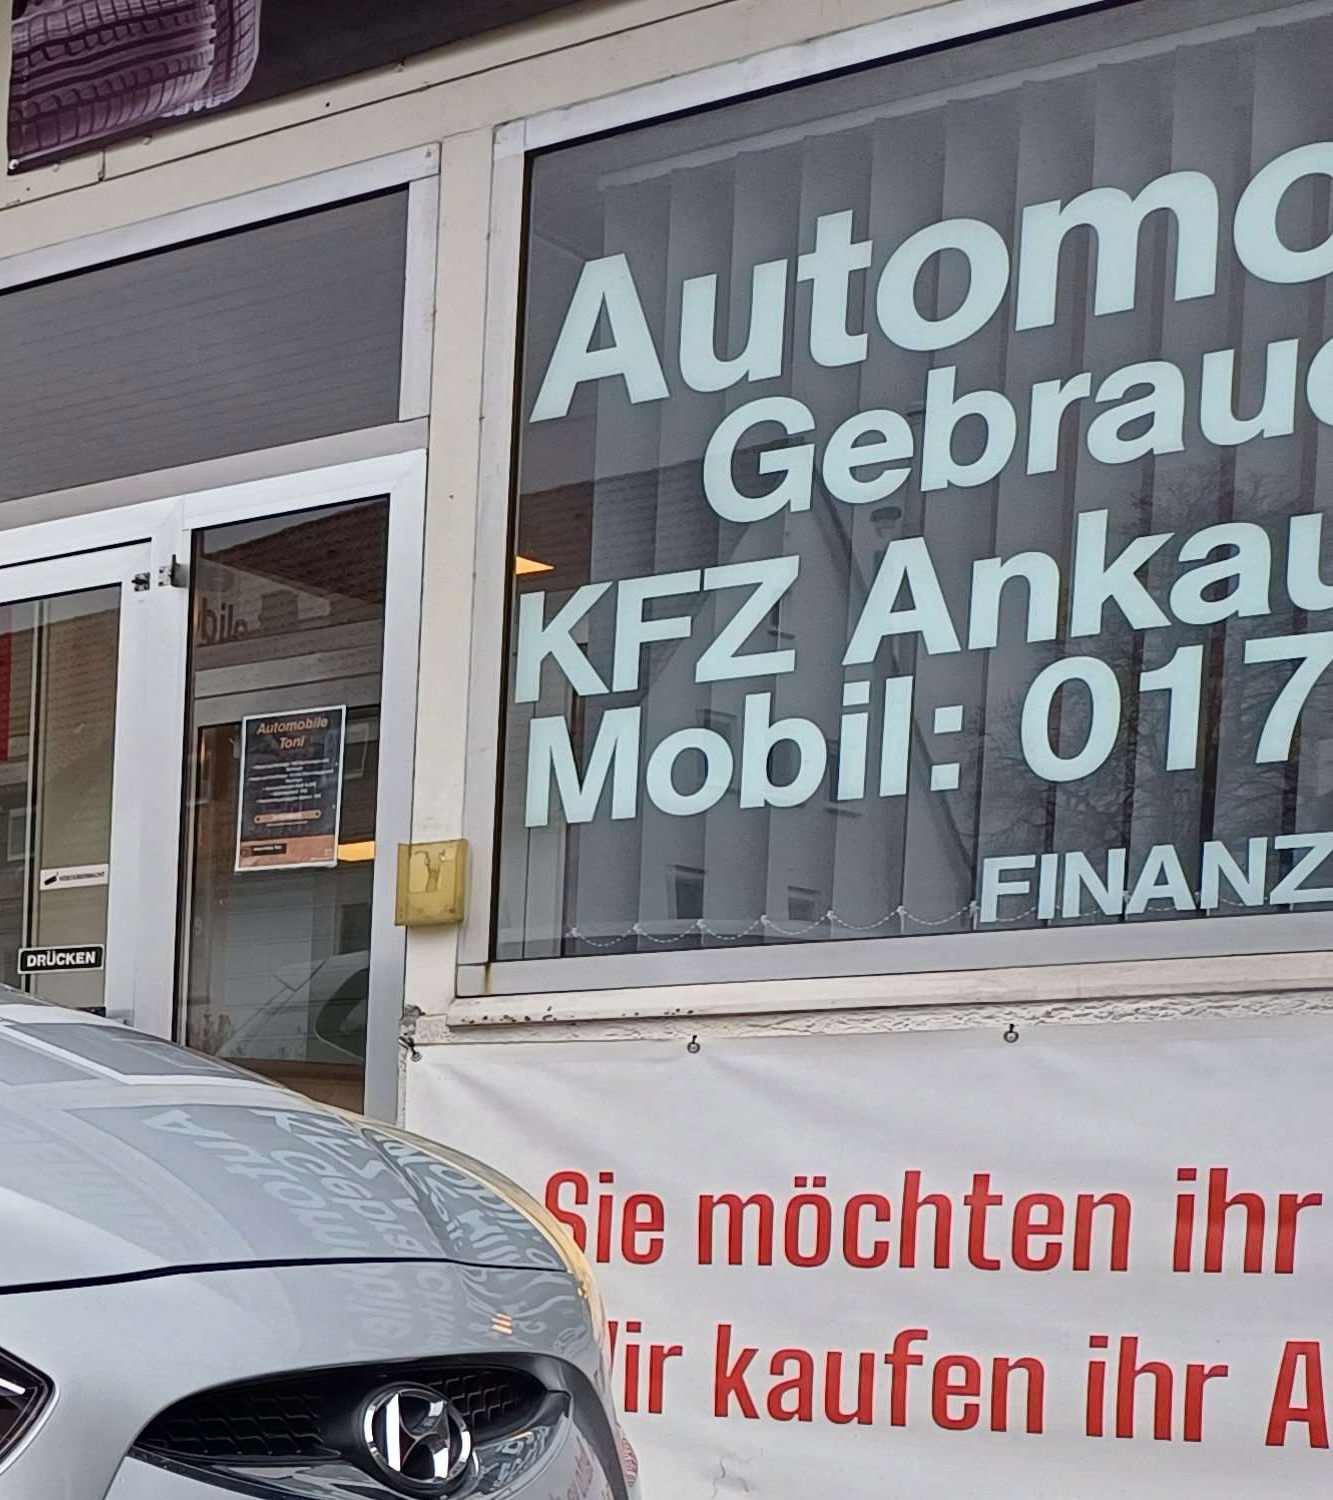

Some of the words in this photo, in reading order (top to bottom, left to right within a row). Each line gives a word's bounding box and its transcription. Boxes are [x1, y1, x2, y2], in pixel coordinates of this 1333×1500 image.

[703, 338, 1333, 524] Gebrau
[514, 555, 801, 704] KFZ
[256, 716, 329, 735] Automobile
[278, 736, 305, 750] Toni
[524, 676, 964, 829] Mobil:
[1019, 632, 1333, 784] 017
[979, 832, 1333, 923] FINANZ
[26, 950, 96, 967] DRÜCKEN
[544, 1170, 665, 1266] Sie
[697, 1169, 1130, 1272] möchten
[1172, 1167, 1323, 1275] ihr
[605, 1320, 683, 1414] ir
[713, 1324, 1045, 1435] kaufen
[1084, 1336, 1229, 1443] ihr
